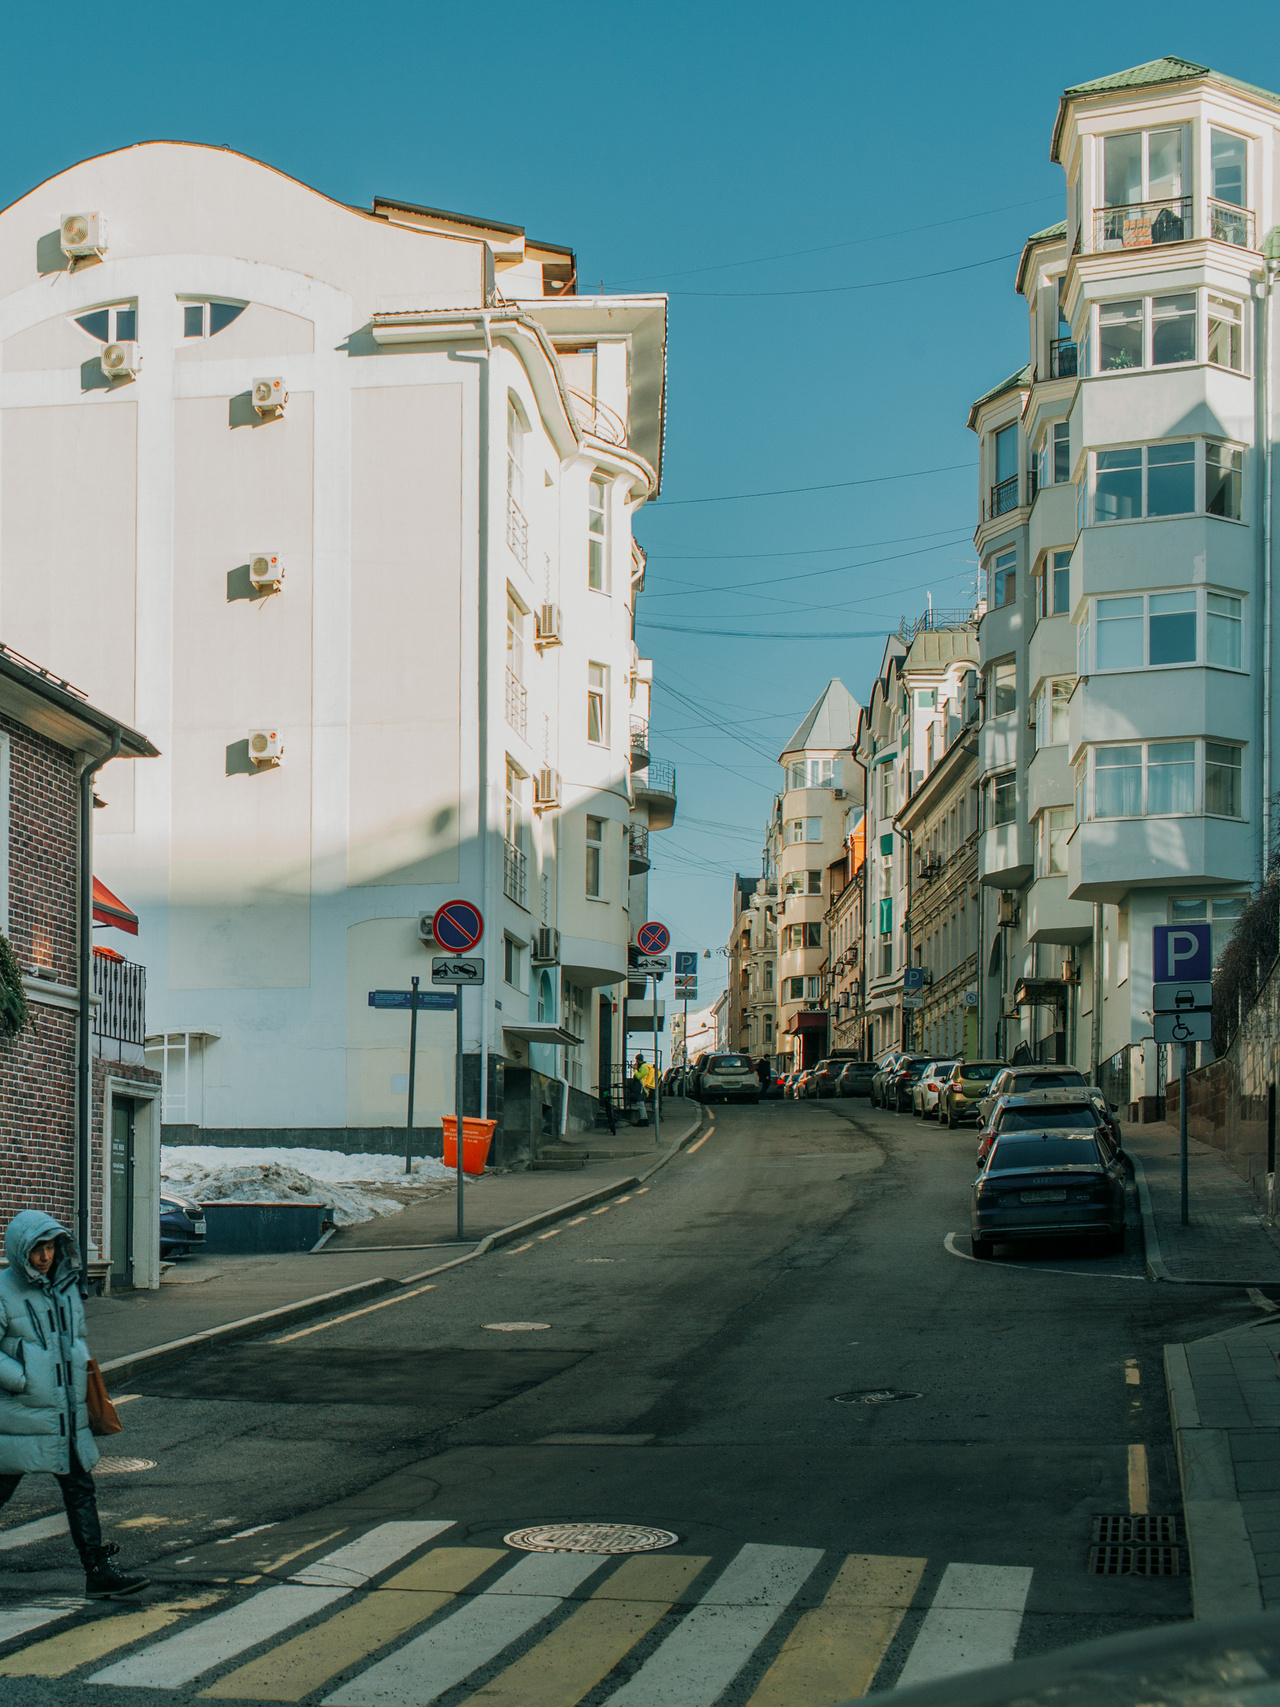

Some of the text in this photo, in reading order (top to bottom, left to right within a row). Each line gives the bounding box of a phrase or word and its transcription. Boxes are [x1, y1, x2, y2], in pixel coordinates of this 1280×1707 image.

[1167, 931, 1199, 977] P
[681, 955, 693, 971] P
[908, 971, 920, 985] P
